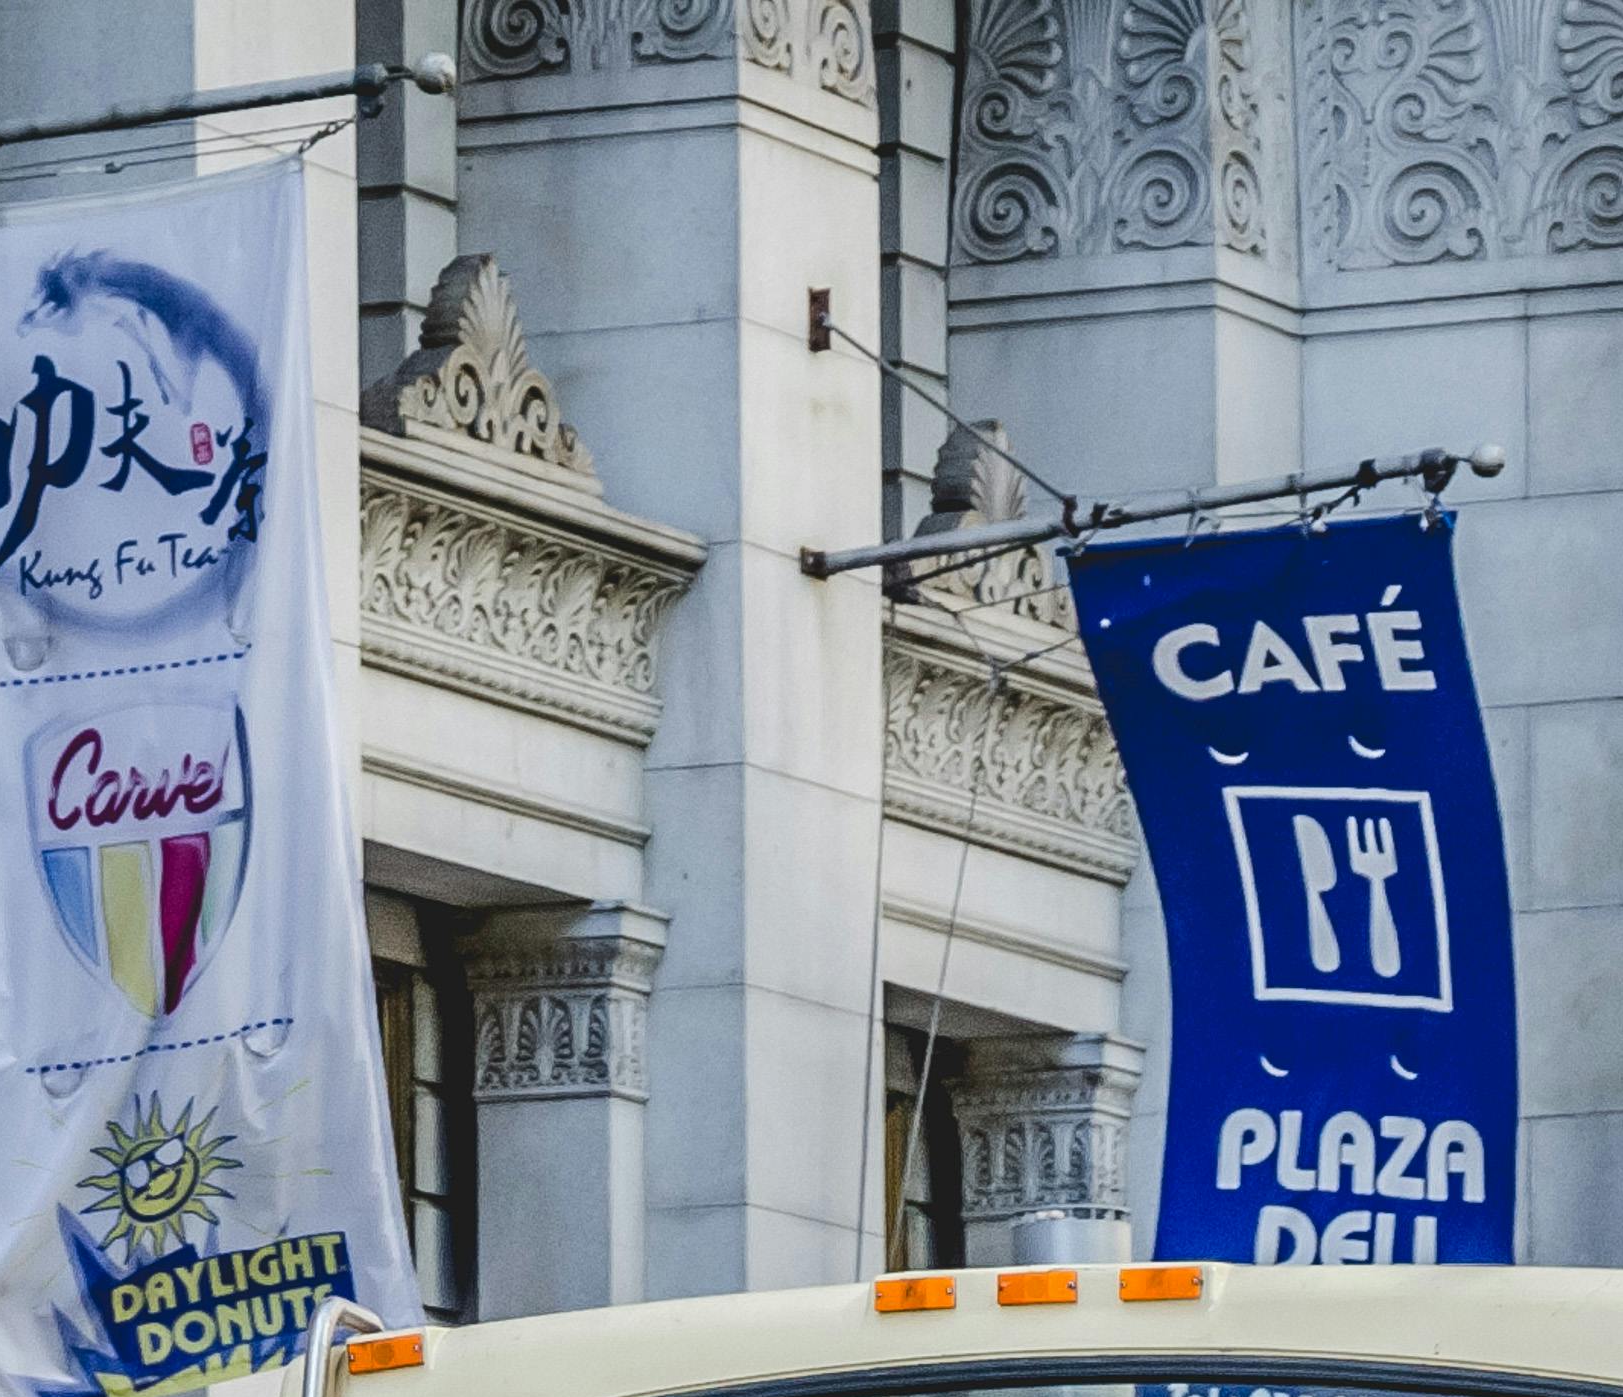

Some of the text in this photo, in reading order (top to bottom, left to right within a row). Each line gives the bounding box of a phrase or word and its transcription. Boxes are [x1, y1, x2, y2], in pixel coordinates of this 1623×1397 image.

[18, 532, 226, 600] Kung Fu Tea
[1152, 584, 1436, 701] CAFÉ
[1216, 1108, 1486, 1202] PLAZA
[111, 1234, 341, 1323] DAYLIGHT
